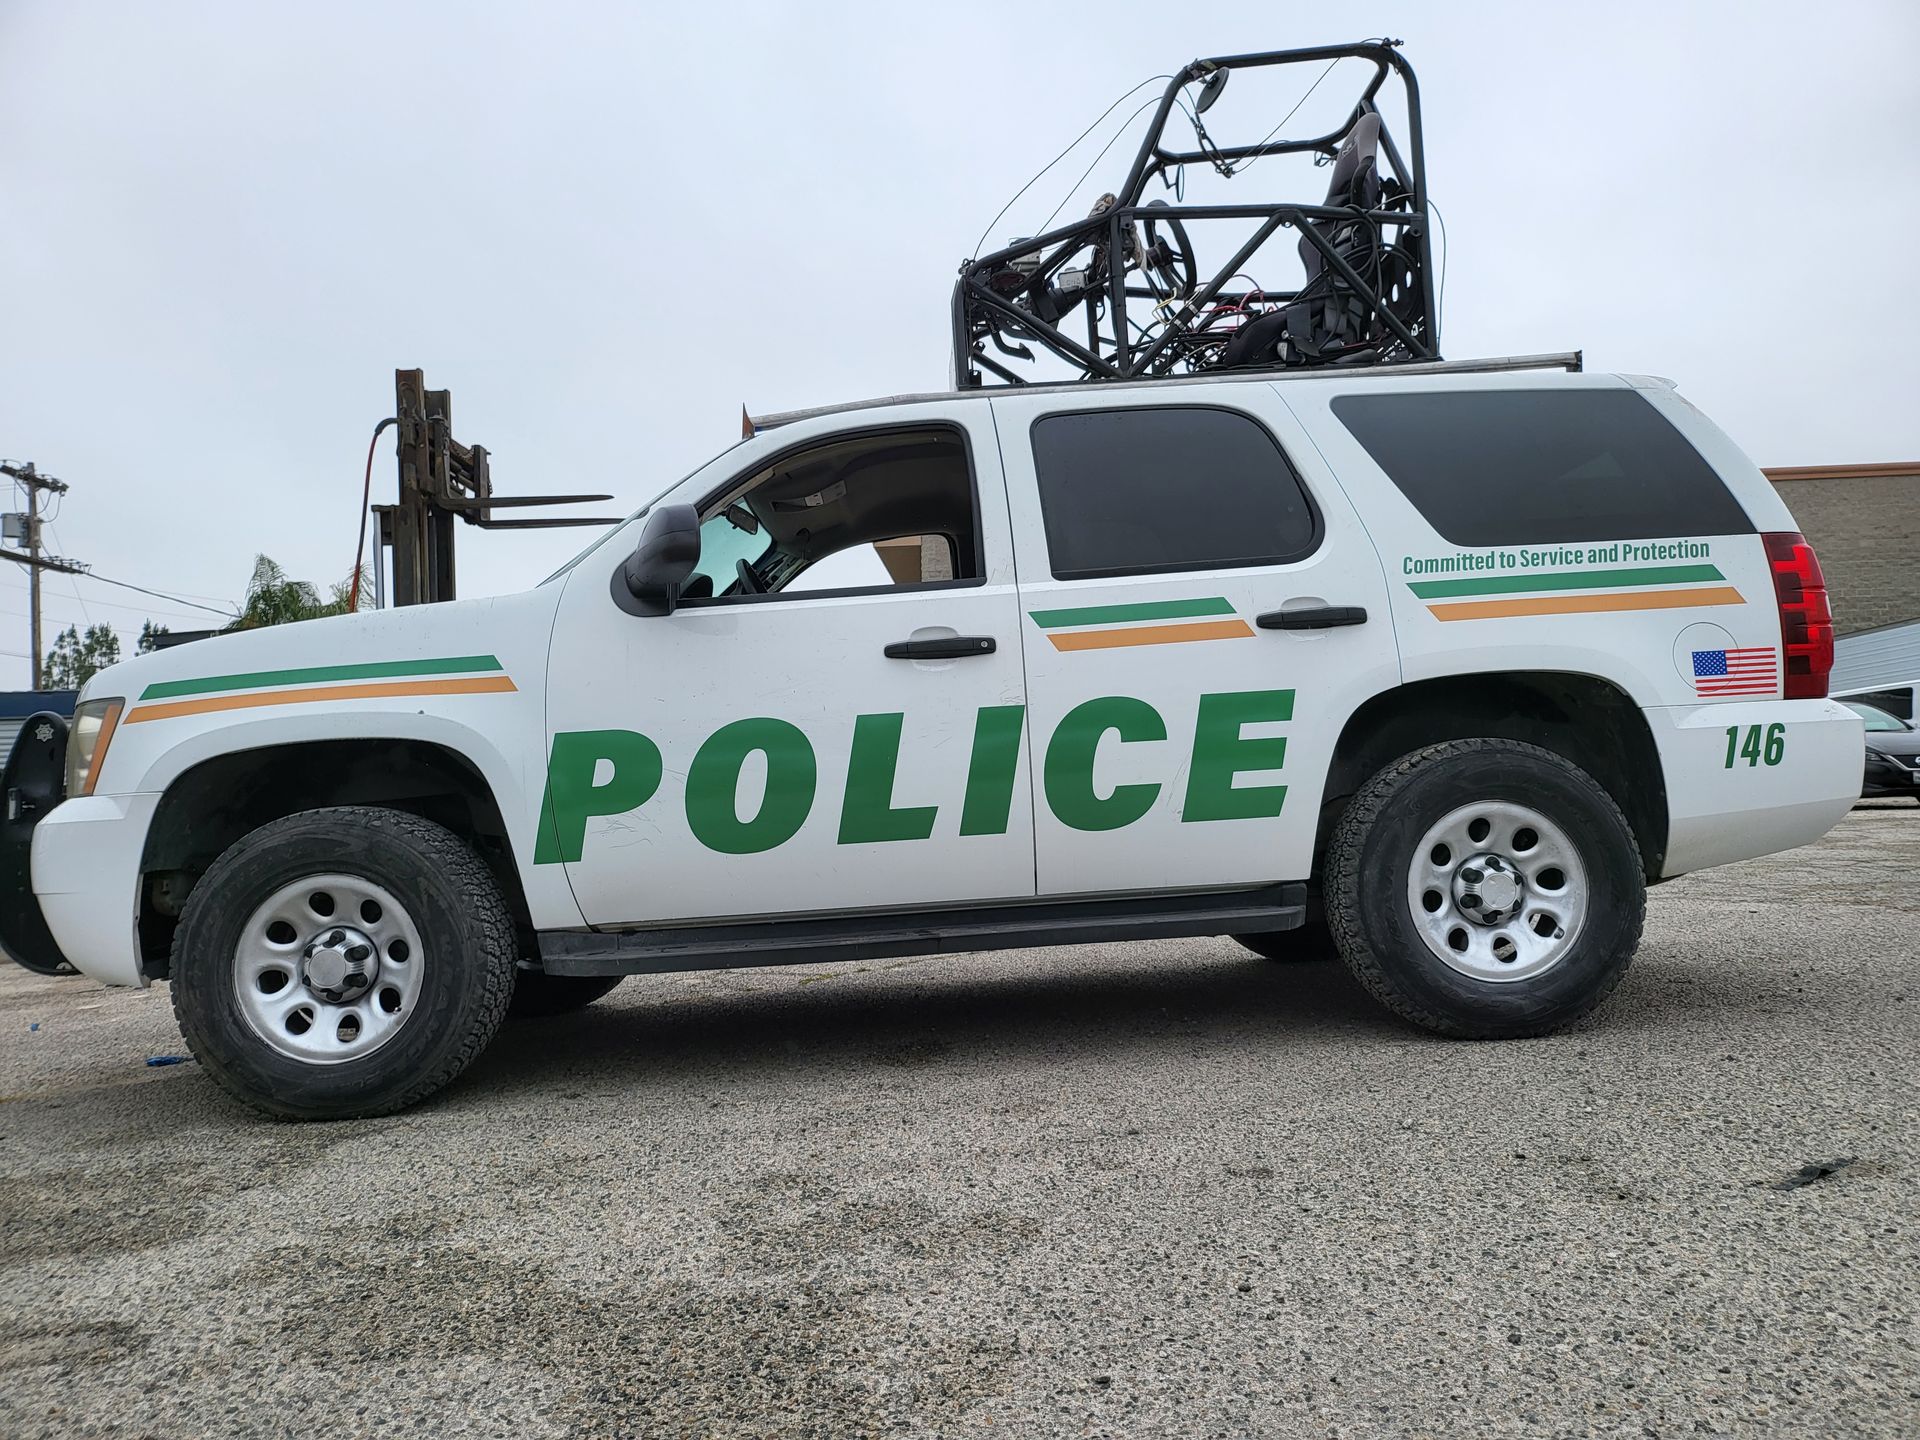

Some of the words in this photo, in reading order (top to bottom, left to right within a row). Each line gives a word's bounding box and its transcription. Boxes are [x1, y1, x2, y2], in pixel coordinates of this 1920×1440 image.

[1402, 550, 1495, 575] Committed
[1499, 551, 1516, 569] to
[1520, 547, 1584, 568] Service
[1587, 543, 1618, 564] and
[1622, 539, 1710, 562] Protection
[1725, 722, 1786, 769] 146
[533, 688, 1296, 865] POLICE
